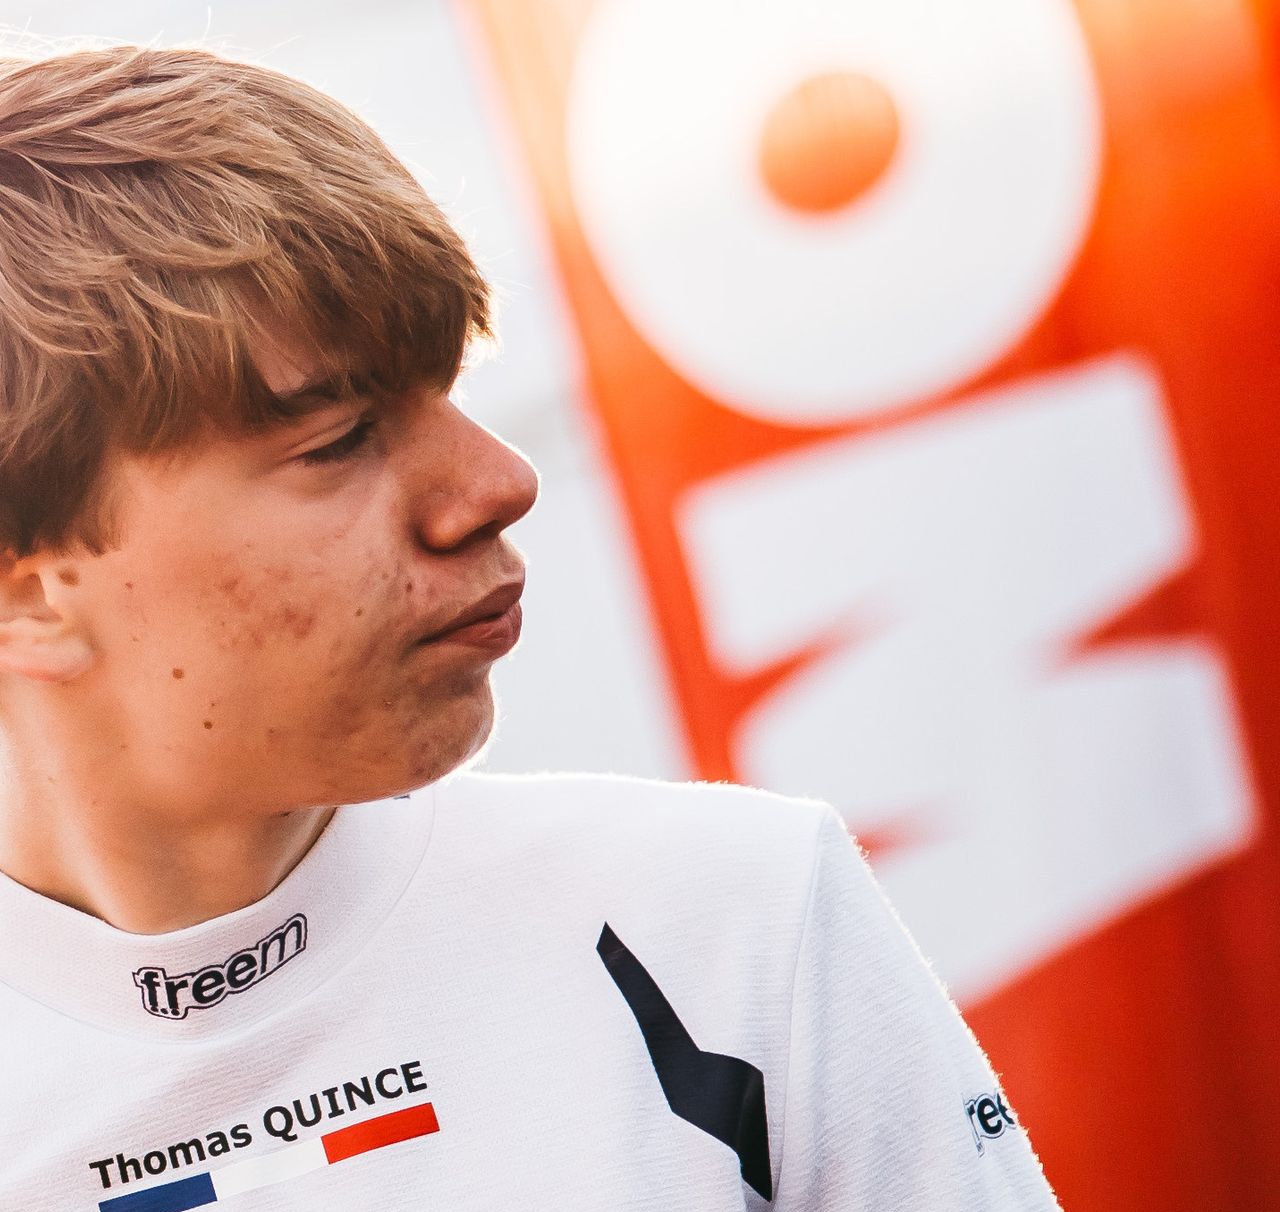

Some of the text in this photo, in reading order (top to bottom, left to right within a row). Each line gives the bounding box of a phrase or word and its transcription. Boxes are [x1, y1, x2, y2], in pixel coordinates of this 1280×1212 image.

[134, 914, 306, 1018] freem
[88, 1060, 428, 1189] Thomas QUINCE
